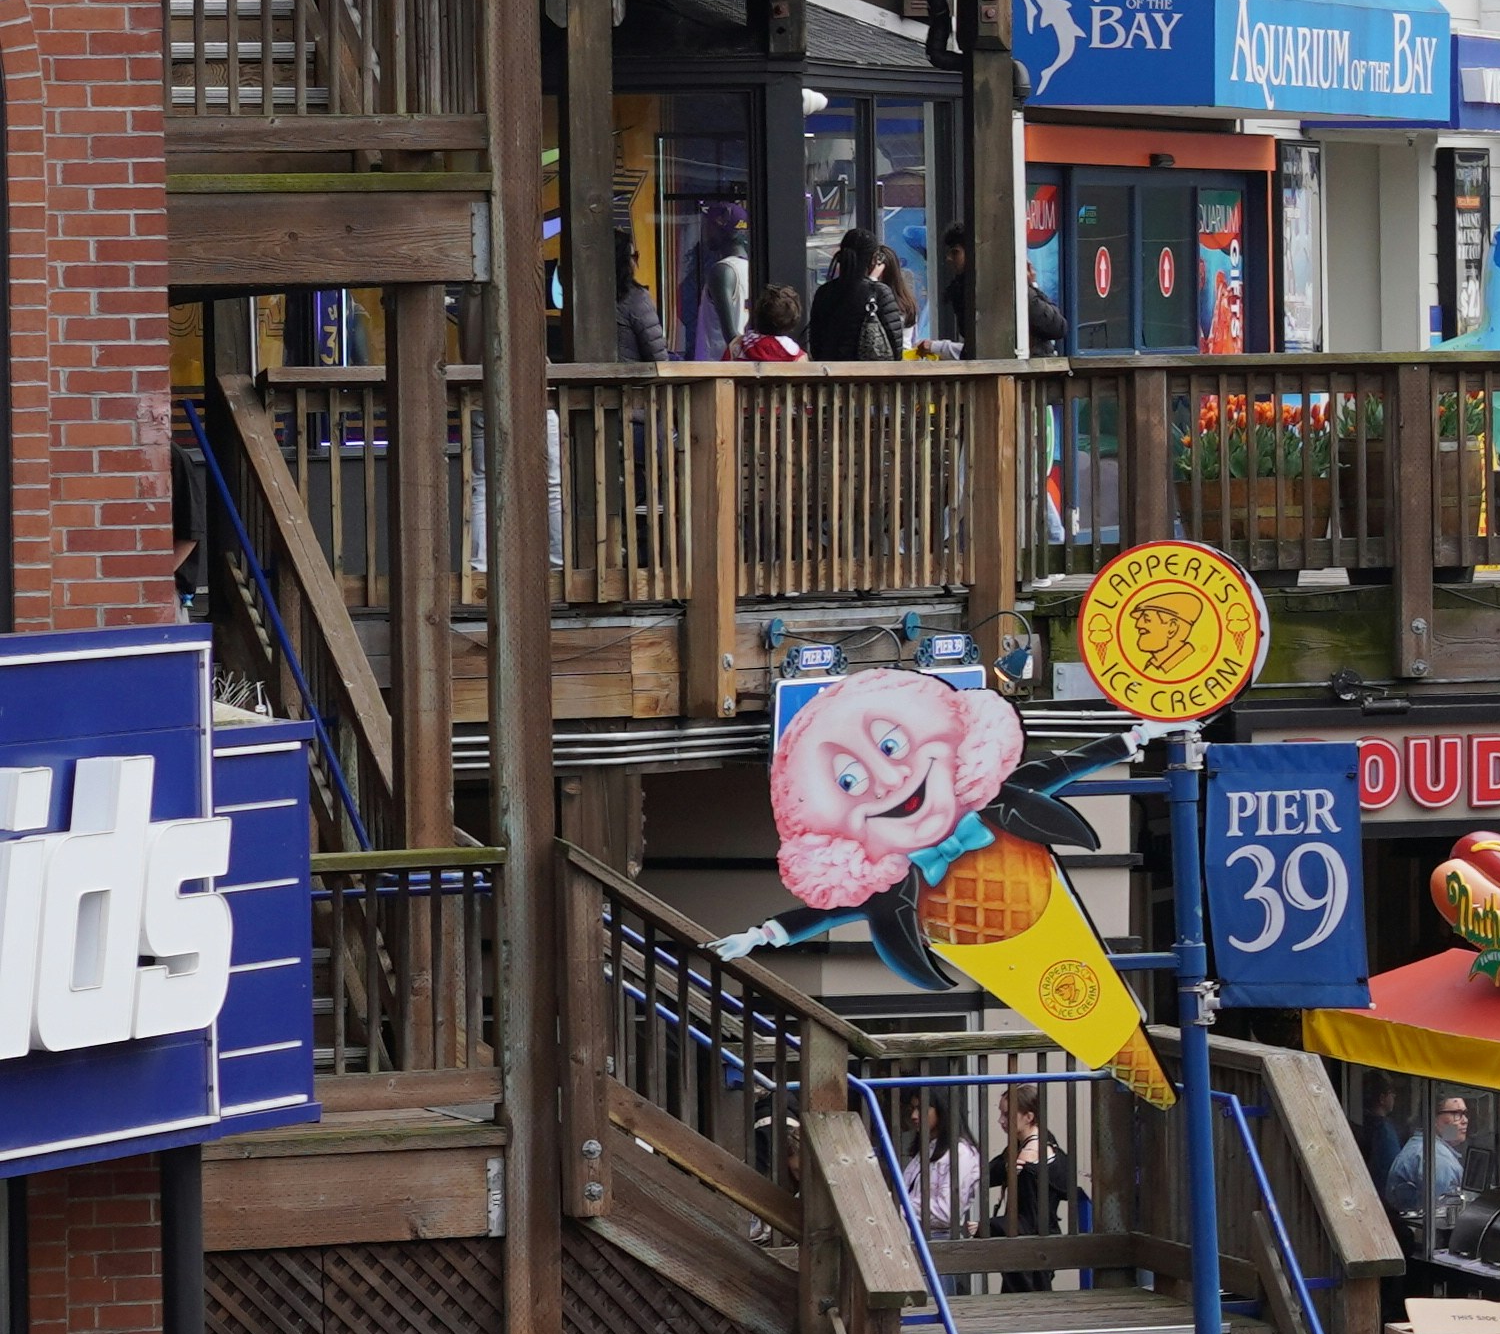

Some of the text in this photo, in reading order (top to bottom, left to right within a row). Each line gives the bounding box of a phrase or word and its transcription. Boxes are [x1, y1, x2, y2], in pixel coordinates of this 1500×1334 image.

[1089, 6, 1183, 51] BAY
[1126, 0, 1173, 10] OF THE
[1351, 60, 1368, 92] OF
[1369, 61, 1391, 94] THE
[1392, 13, 1438, 95] BAY
[1229, 238, 1241, 339] GIFTS
[1094, 553, 1239, 610] LAPPERT'S
[802, 650, 832, 665] PIER 39
[935, 640, 963, 655] PIER 39
[1101, 657, 1244, 713] ICE CREAM
[1226, 788, 1343, 837] PIER
[1226, 842, 1349, 953] 39
